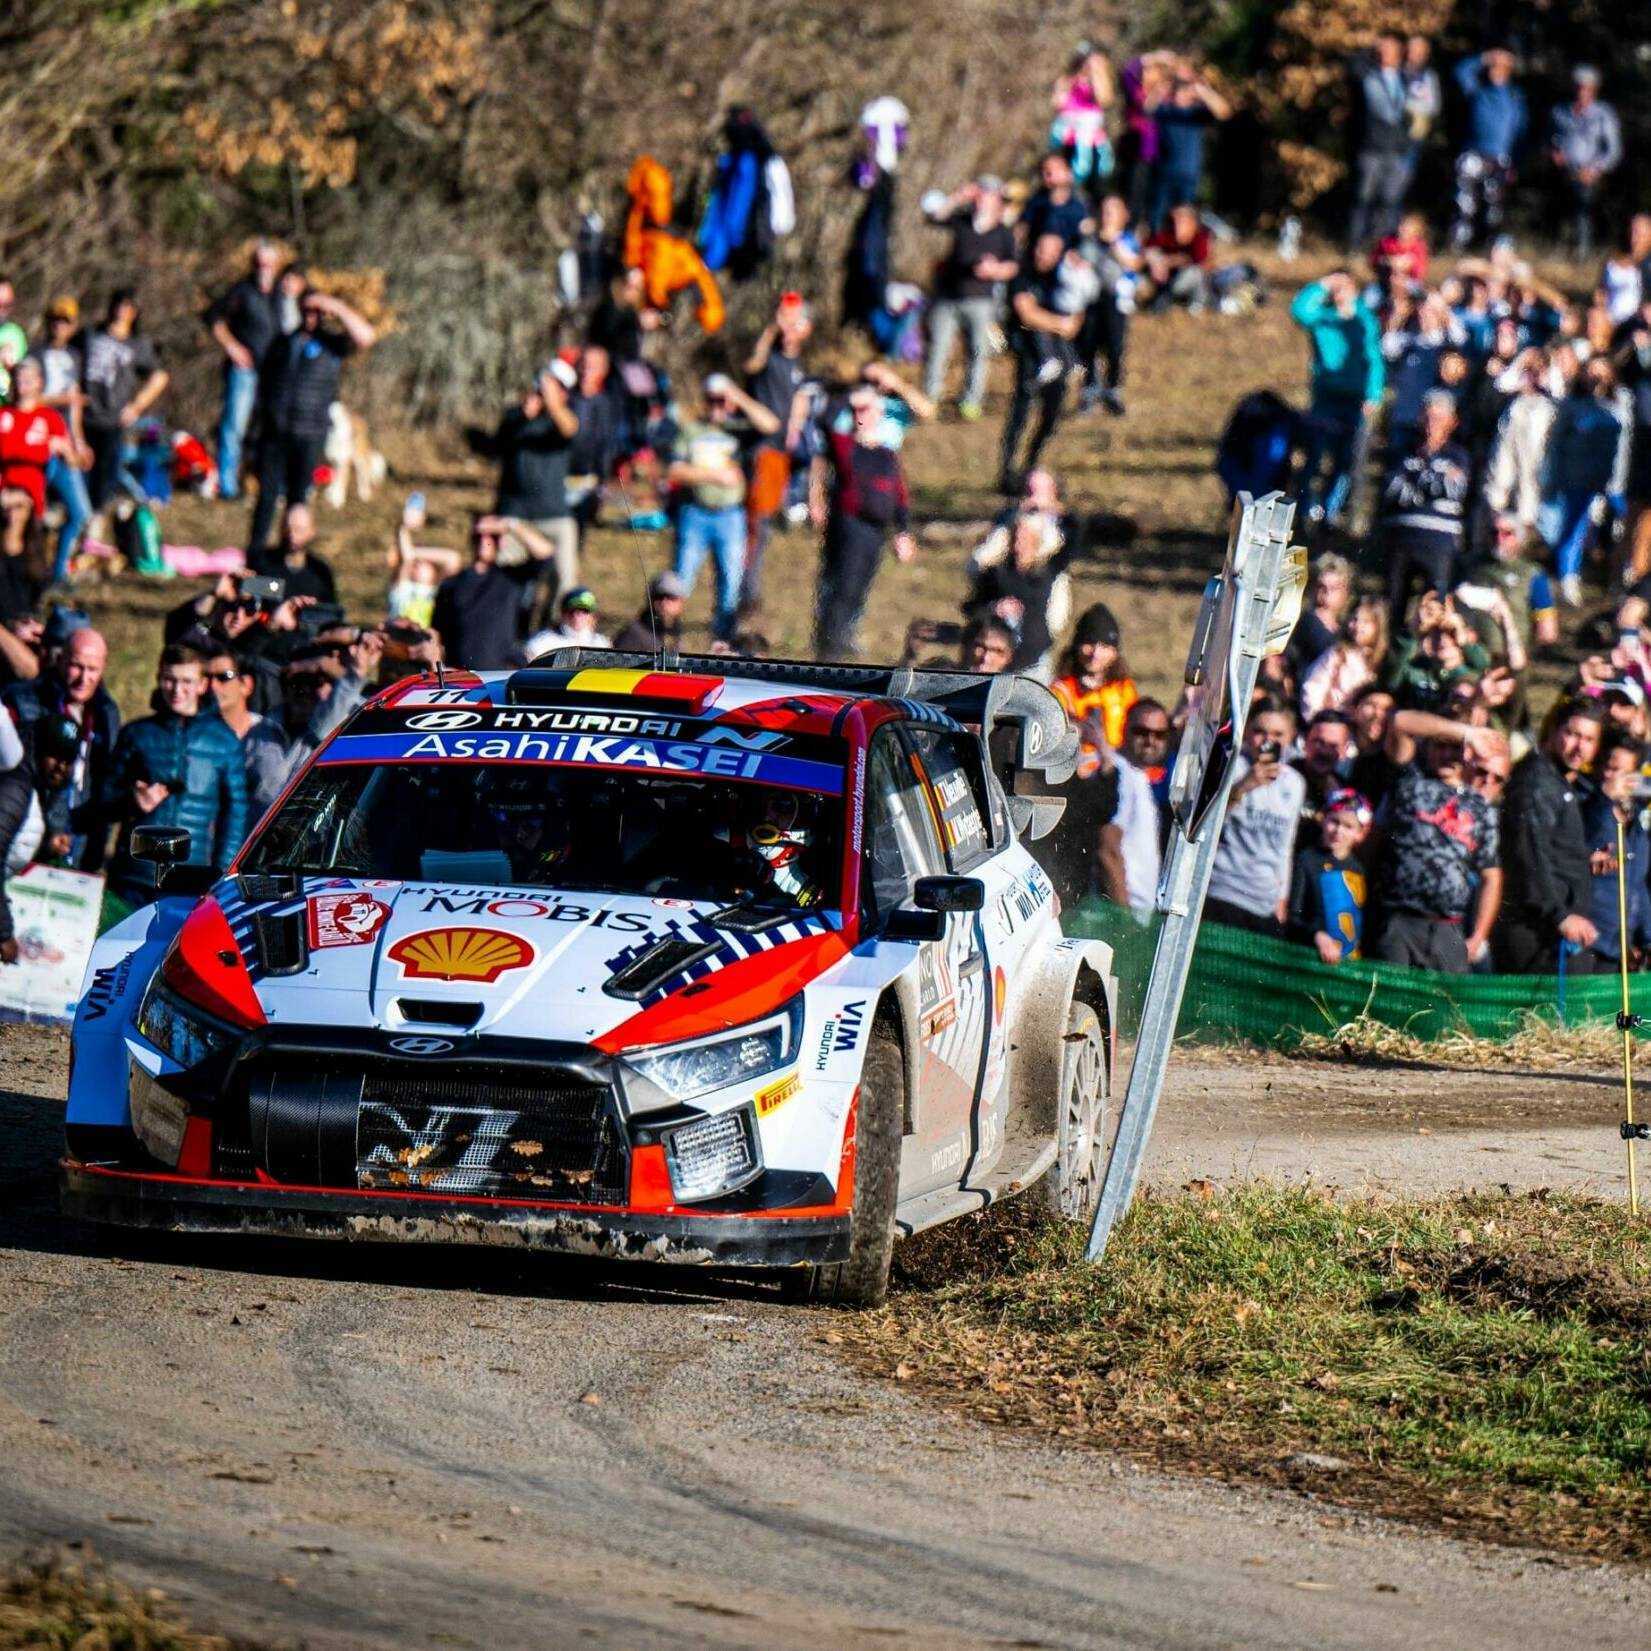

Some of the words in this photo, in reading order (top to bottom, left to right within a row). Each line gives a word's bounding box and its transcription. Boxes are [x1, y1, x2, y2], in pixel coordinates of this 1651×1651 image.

[428, 690, 471, 703] 11
[494, 712, 682, 737] HYUNDAI
[402, 887, 564, 902] HYUNDAI
[422, 897, 653, 931] MOBIS
[84, 967, 117, 1021] WIA
[833, 1000, 867, 1052] WIA
[816, 1021, 836, 1071] HYUNDAI
